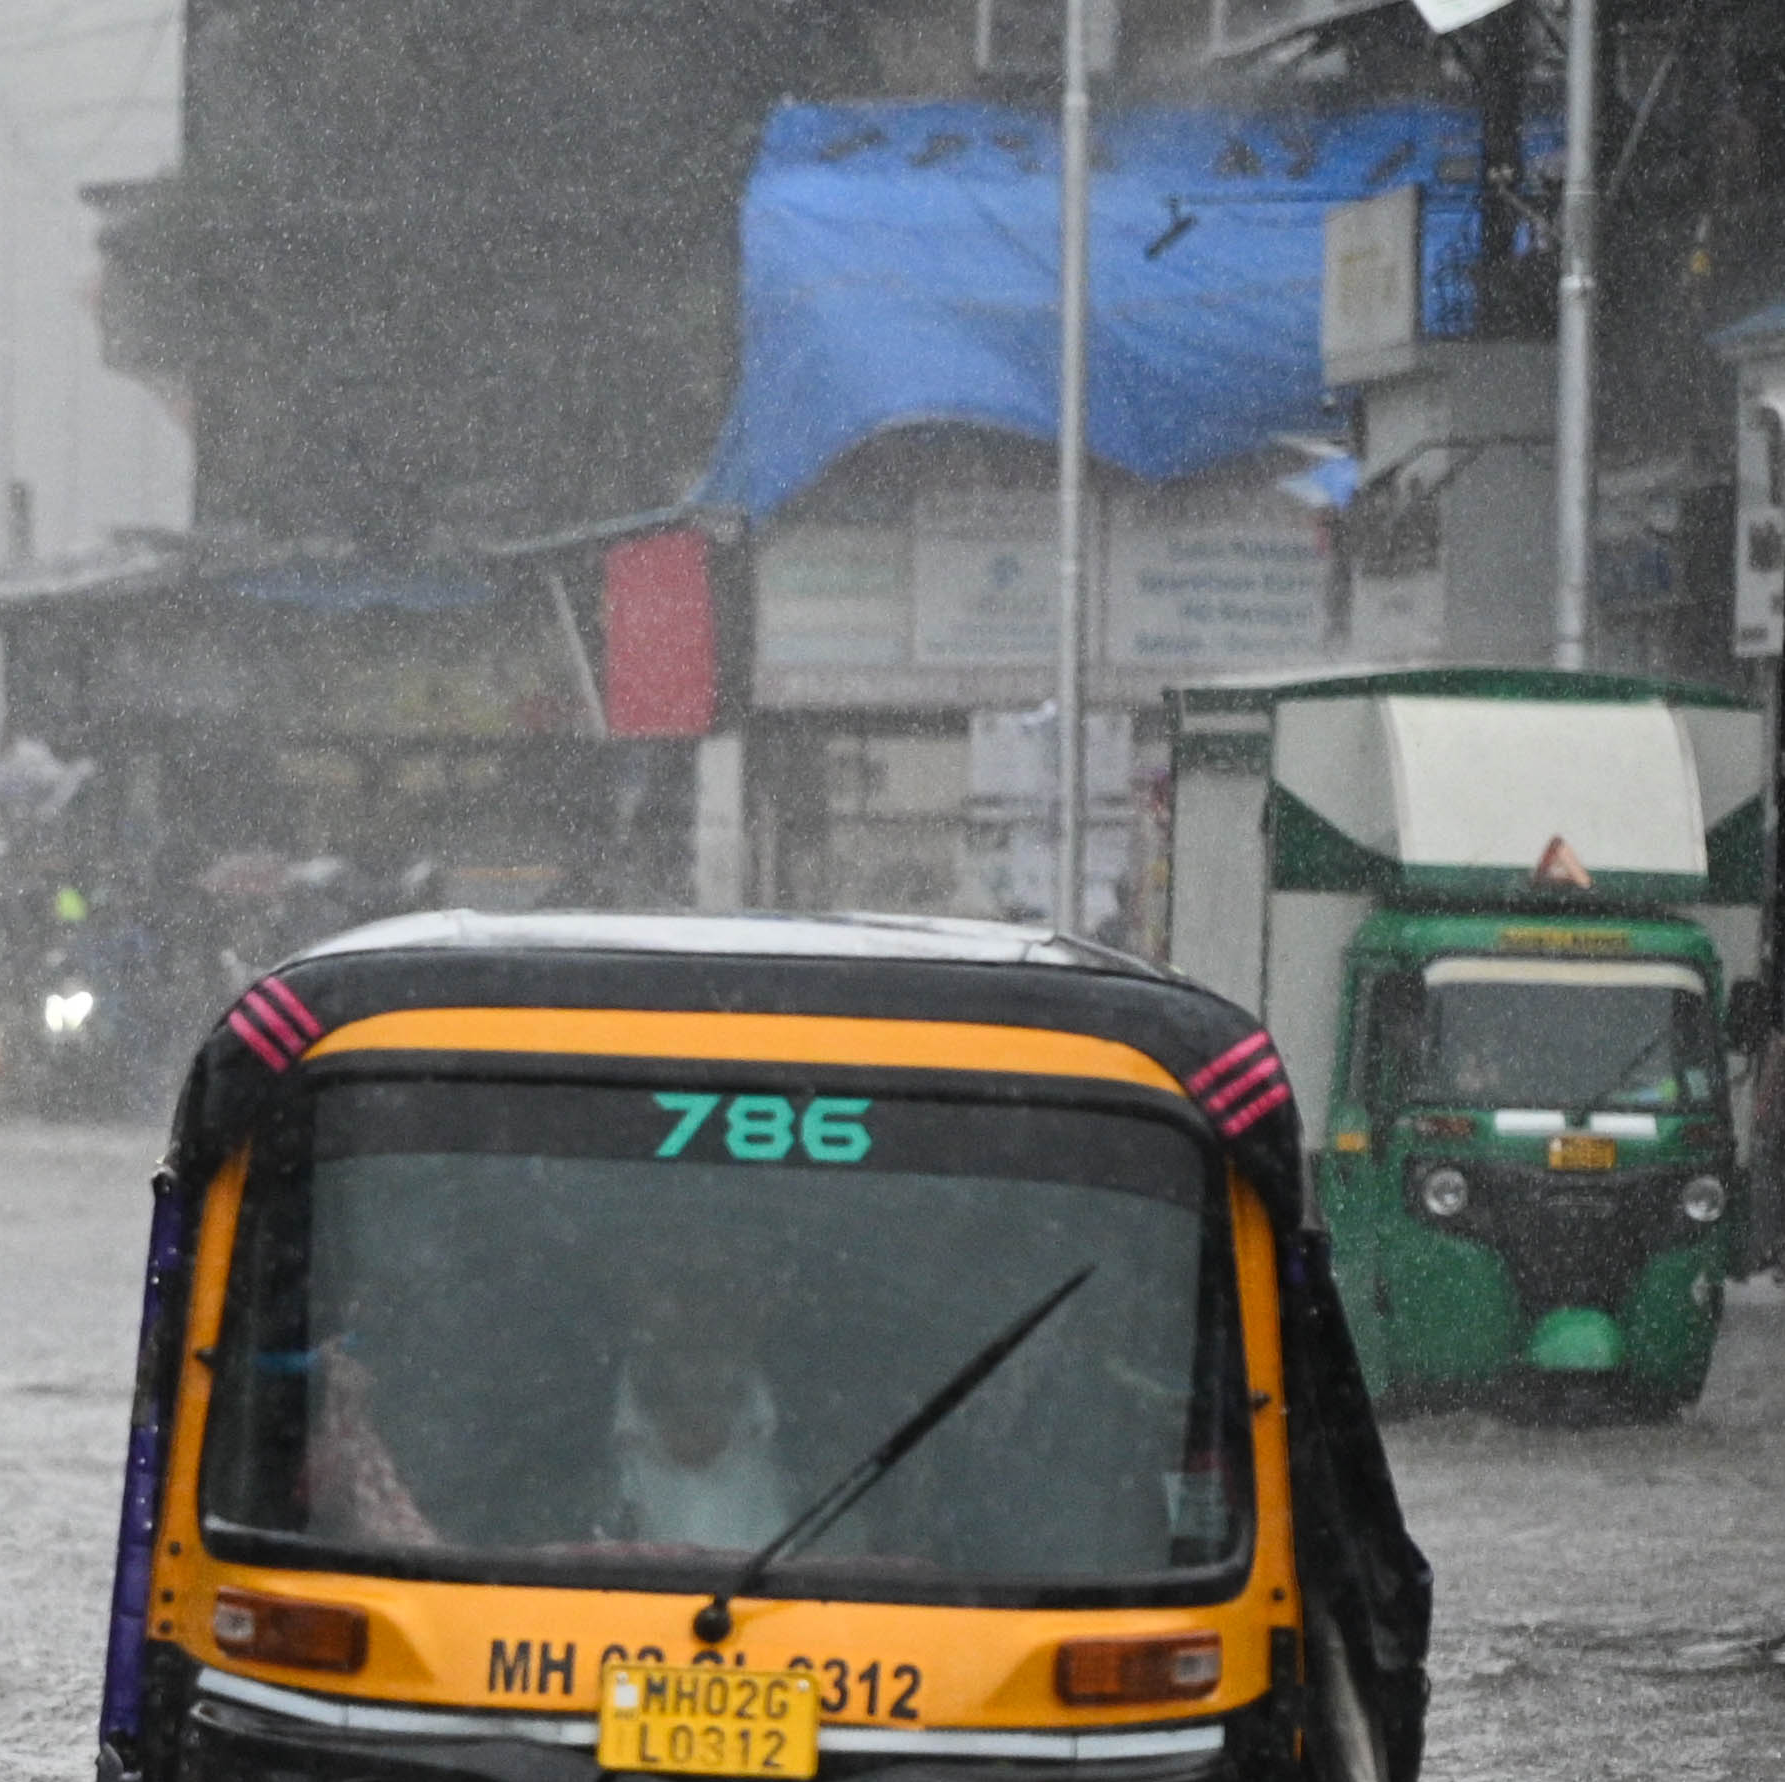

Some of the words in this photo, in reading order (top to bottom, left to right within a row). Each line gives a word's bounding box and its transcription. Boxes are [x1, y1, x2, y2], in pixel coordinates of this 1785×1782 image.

[653, 1092, 873, 1162] 786
[487, 1639, 577, 1697] MH
[788, 1655, 922, 1720] 312
[641, 1674, 789, 1720] MH02G
[637, 1722, 787, 1769] L0312
